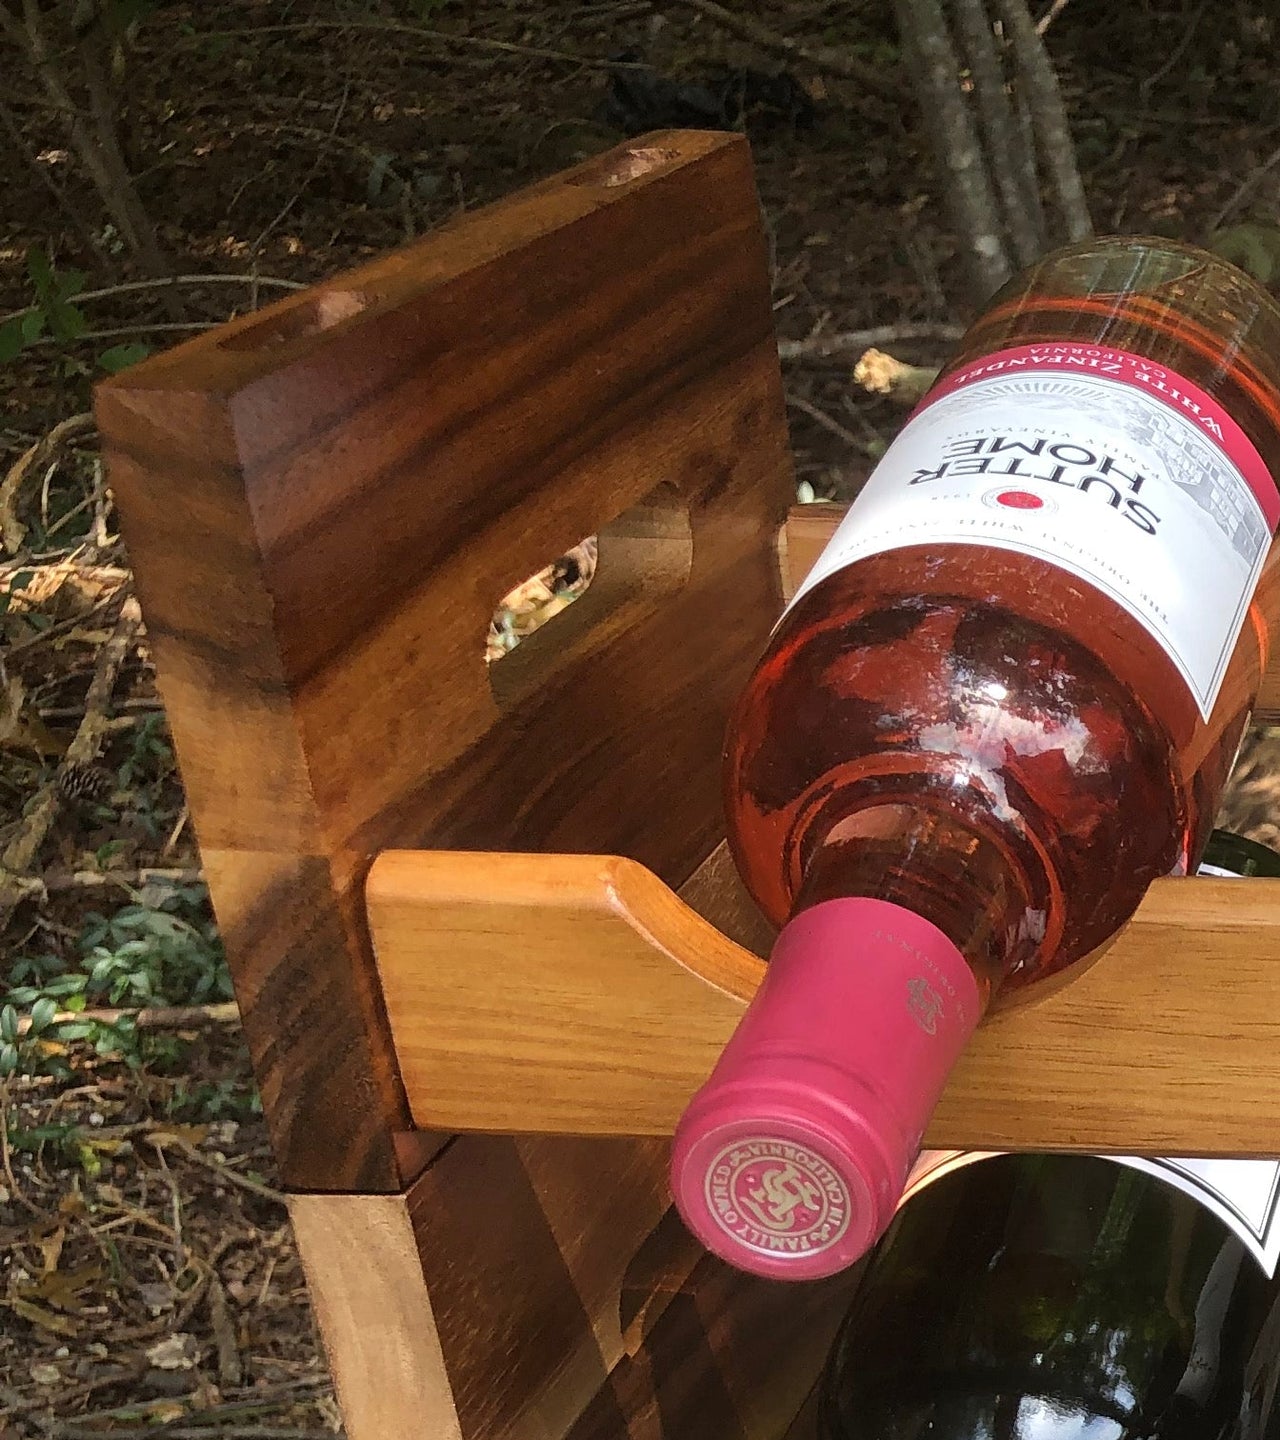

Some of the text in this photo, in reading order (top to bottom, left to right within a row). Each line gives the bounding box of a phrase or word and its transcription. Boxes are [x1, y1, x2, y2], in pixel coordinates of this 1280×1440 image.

[954, 353, 1226, 443] WHITE ZINFANDEL
[1029, 347, 1167, 380] CALIFORNIA
[906, 456, 1163, 537] SUTTER
[942, 436, 1147, 495] HOME
